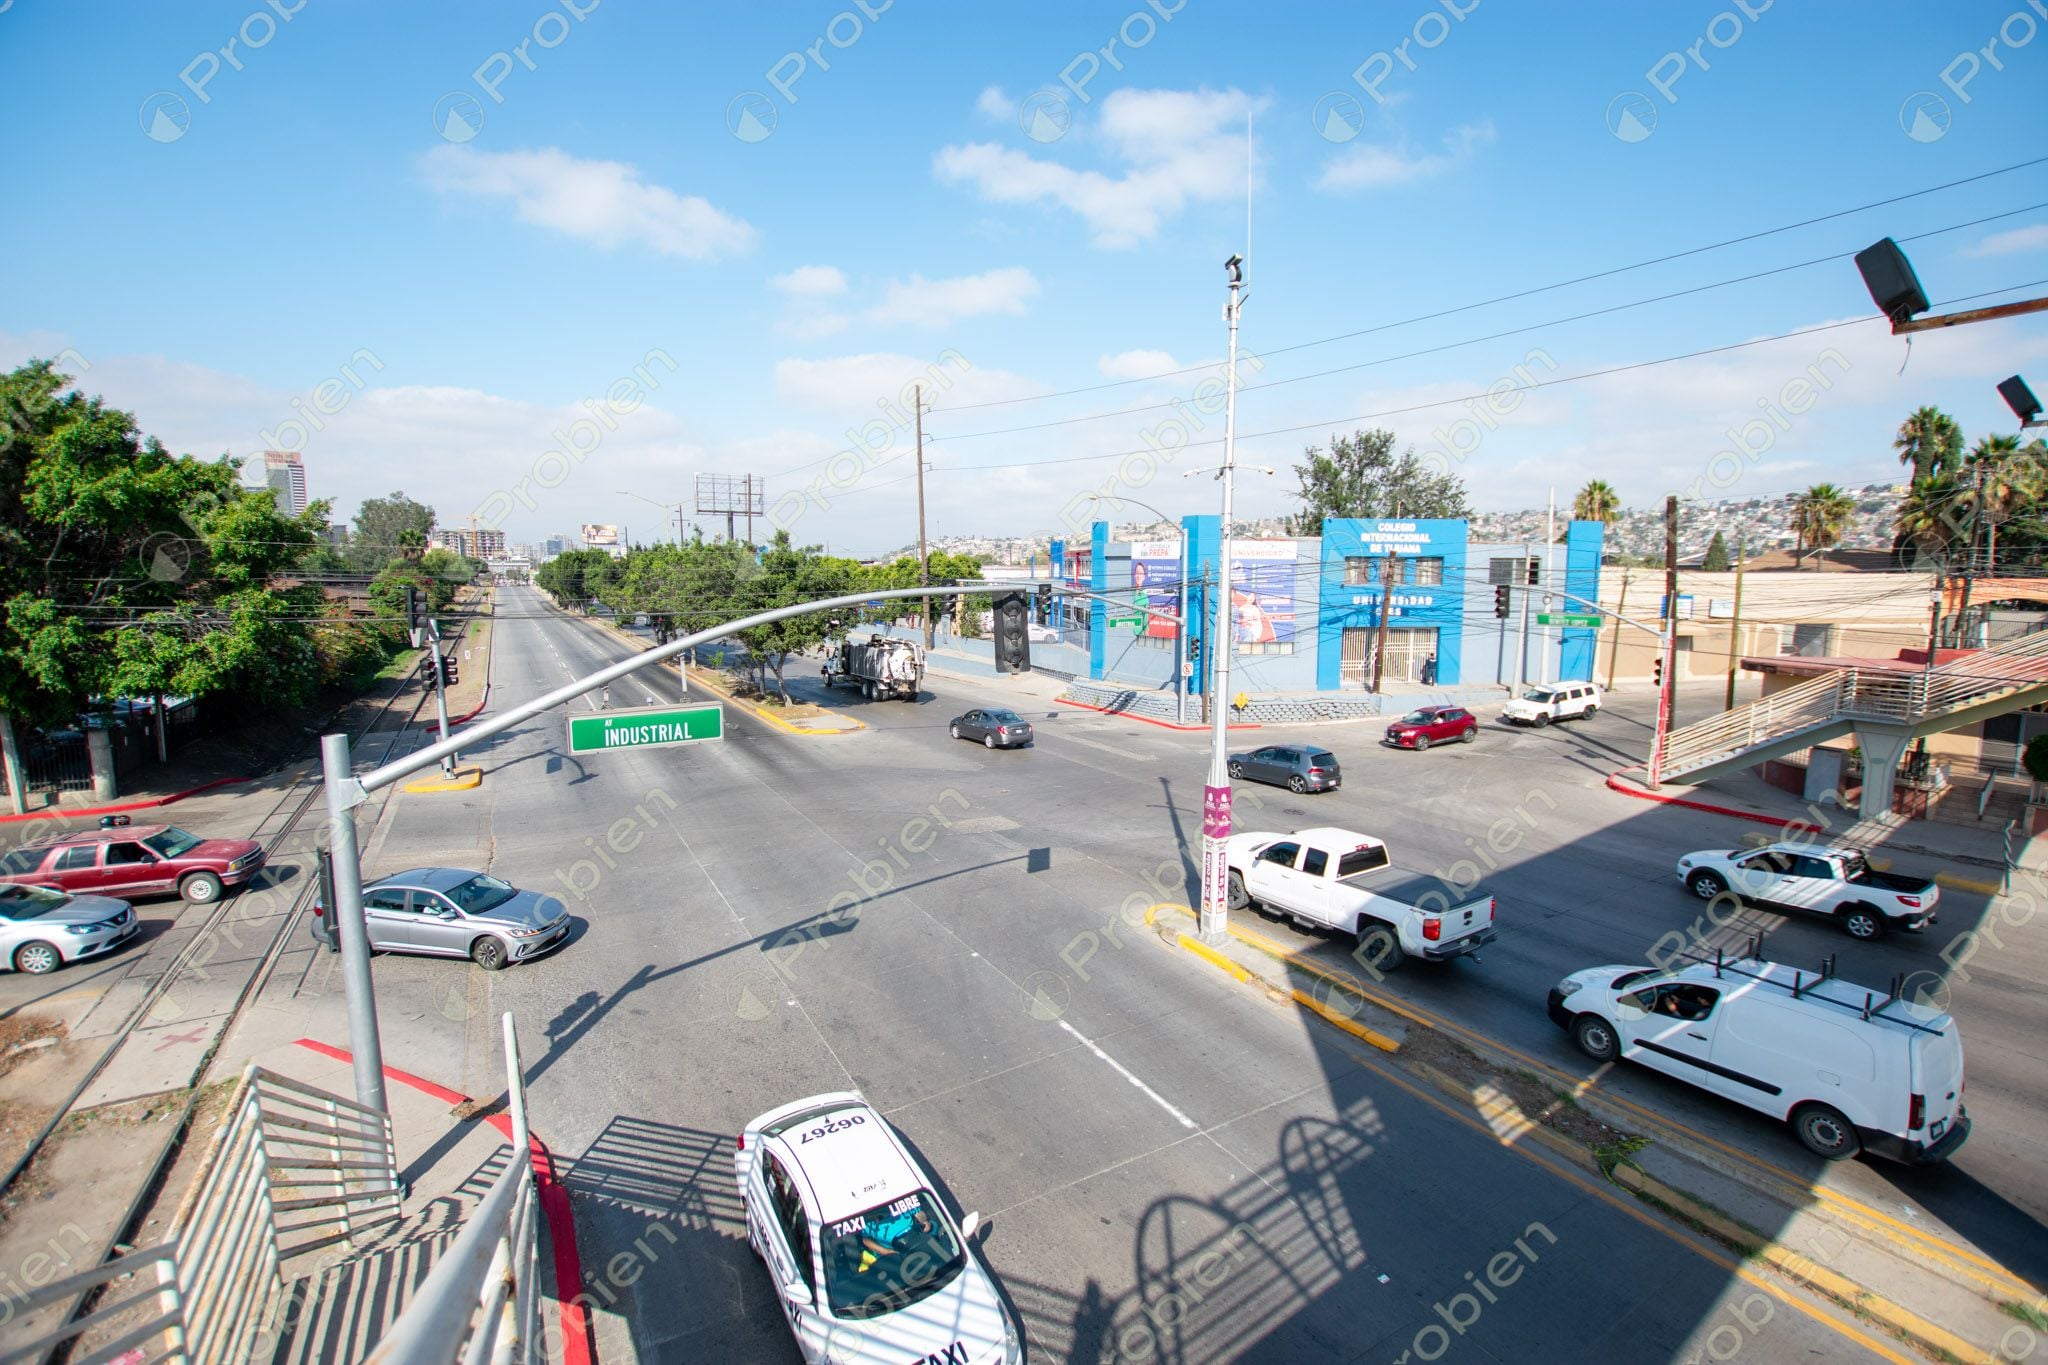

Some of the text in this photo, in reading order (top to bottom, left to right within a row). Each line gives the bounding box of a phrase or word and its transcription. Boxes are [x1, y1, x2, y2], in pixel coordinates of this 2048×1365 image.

[1378, 522, 1416, 532] COLEGIO
[1361, 533, 1431, 542] INTERNACIONAL
[1370, 544, 1421, 553] DE TIJUANA
[1353, 596, 1432, 605] UNIVRSIDAD
[605, 719, 613, 727] AV
[605, 722, 692, 747] INDUSTRIAL
[801, 1115, 866, 1145] 06267
[832, 1195, 921, 1238] TAXI LIBRE
